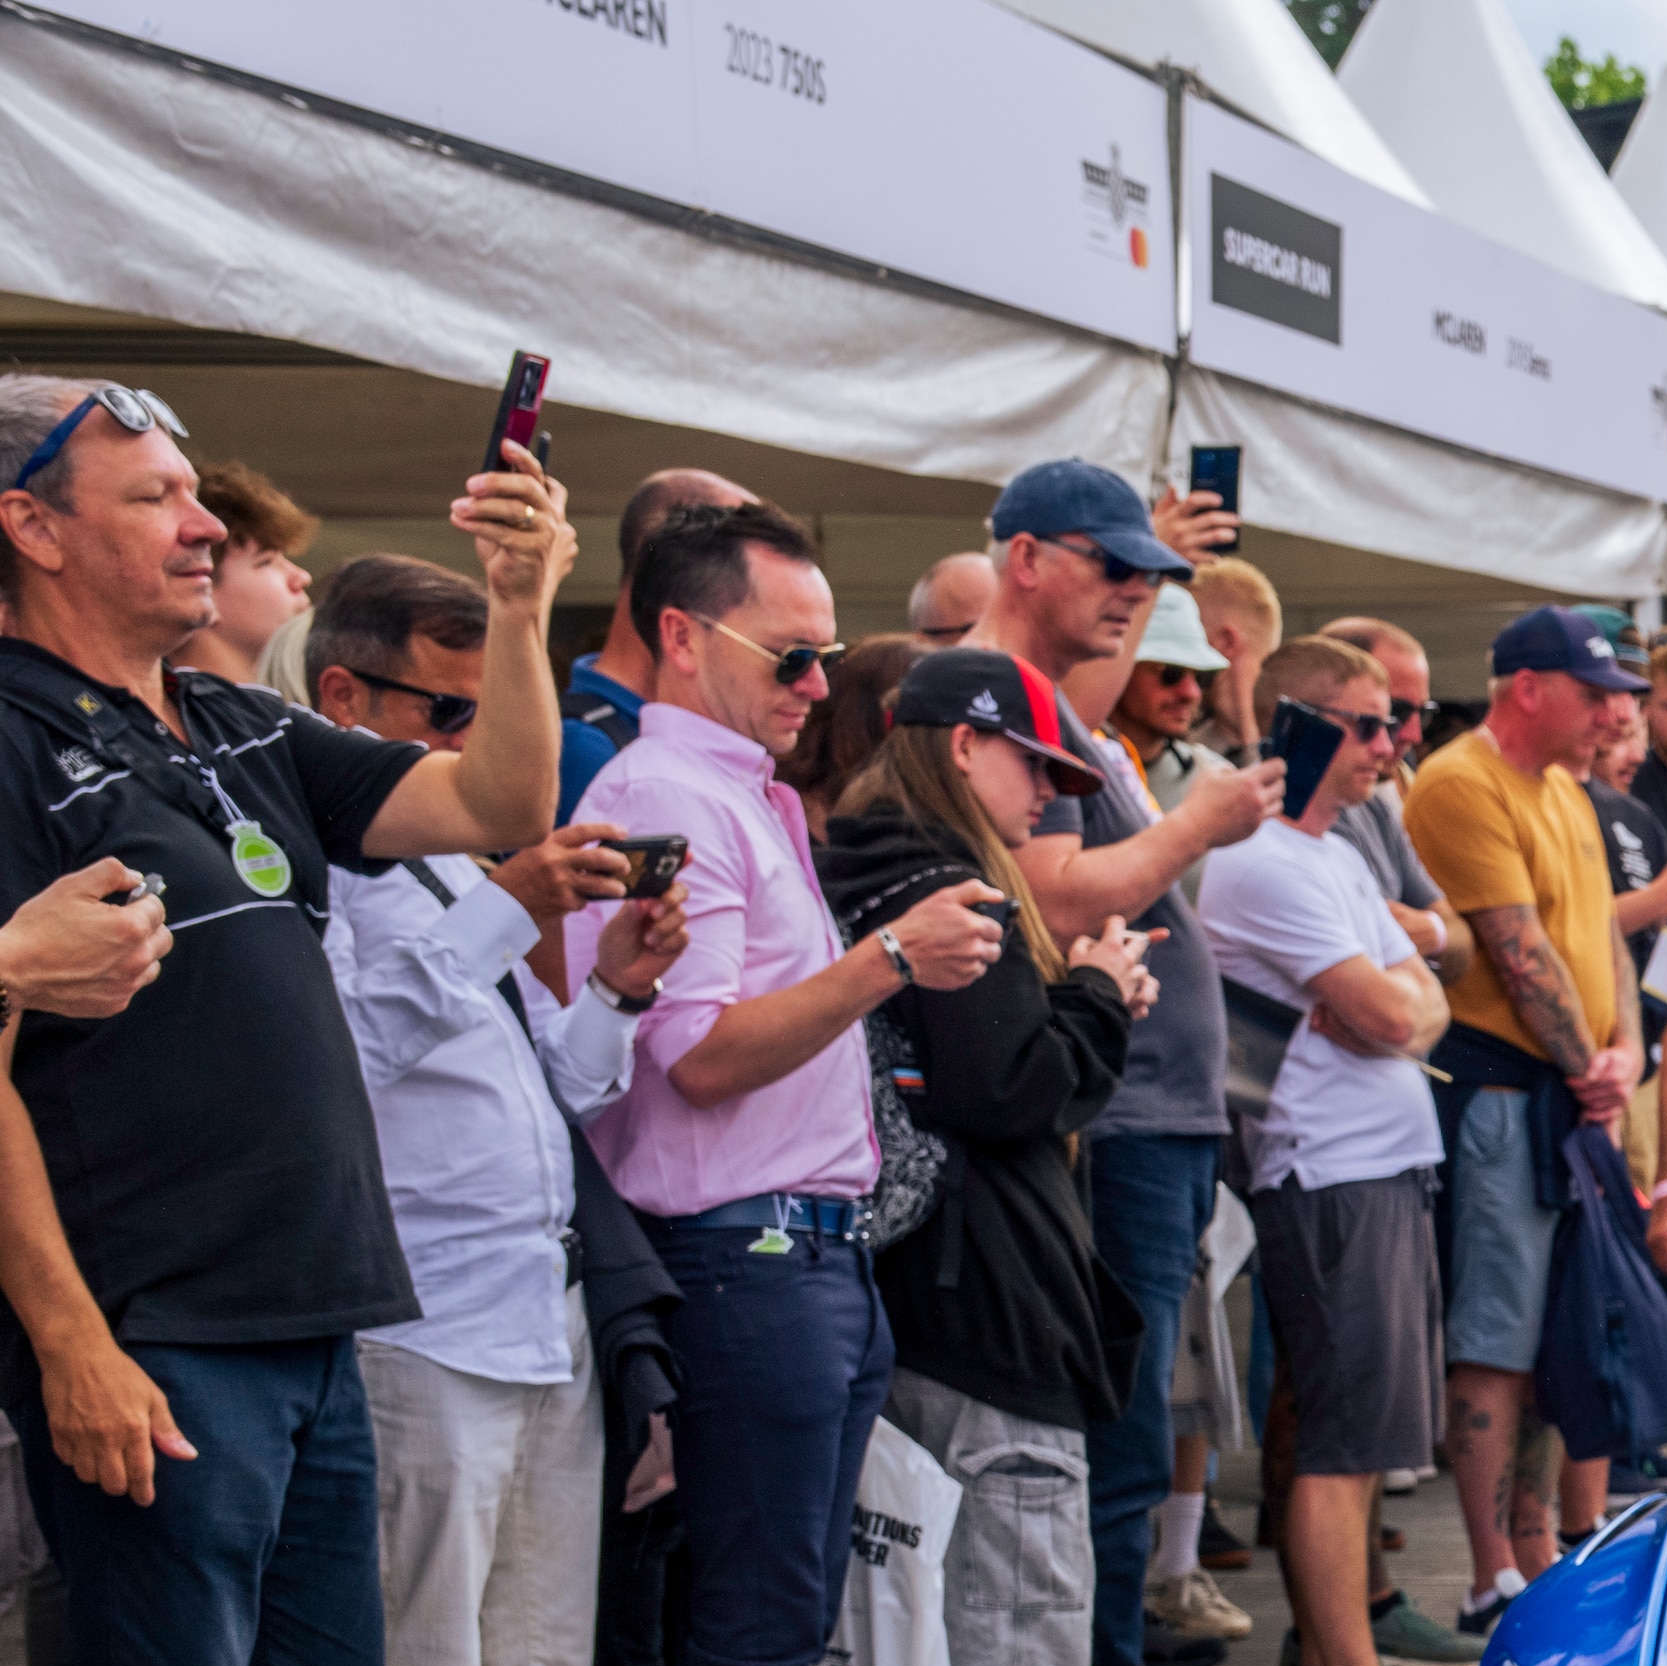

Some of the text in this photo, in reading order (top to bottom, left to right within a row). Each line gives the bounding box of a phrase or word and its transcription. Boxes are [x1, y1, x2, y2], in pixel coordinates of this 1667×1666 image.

[725, 22, 826, 105] 2023 750S
[1223, 225, 1332, 299] SUPERCAR RUN
